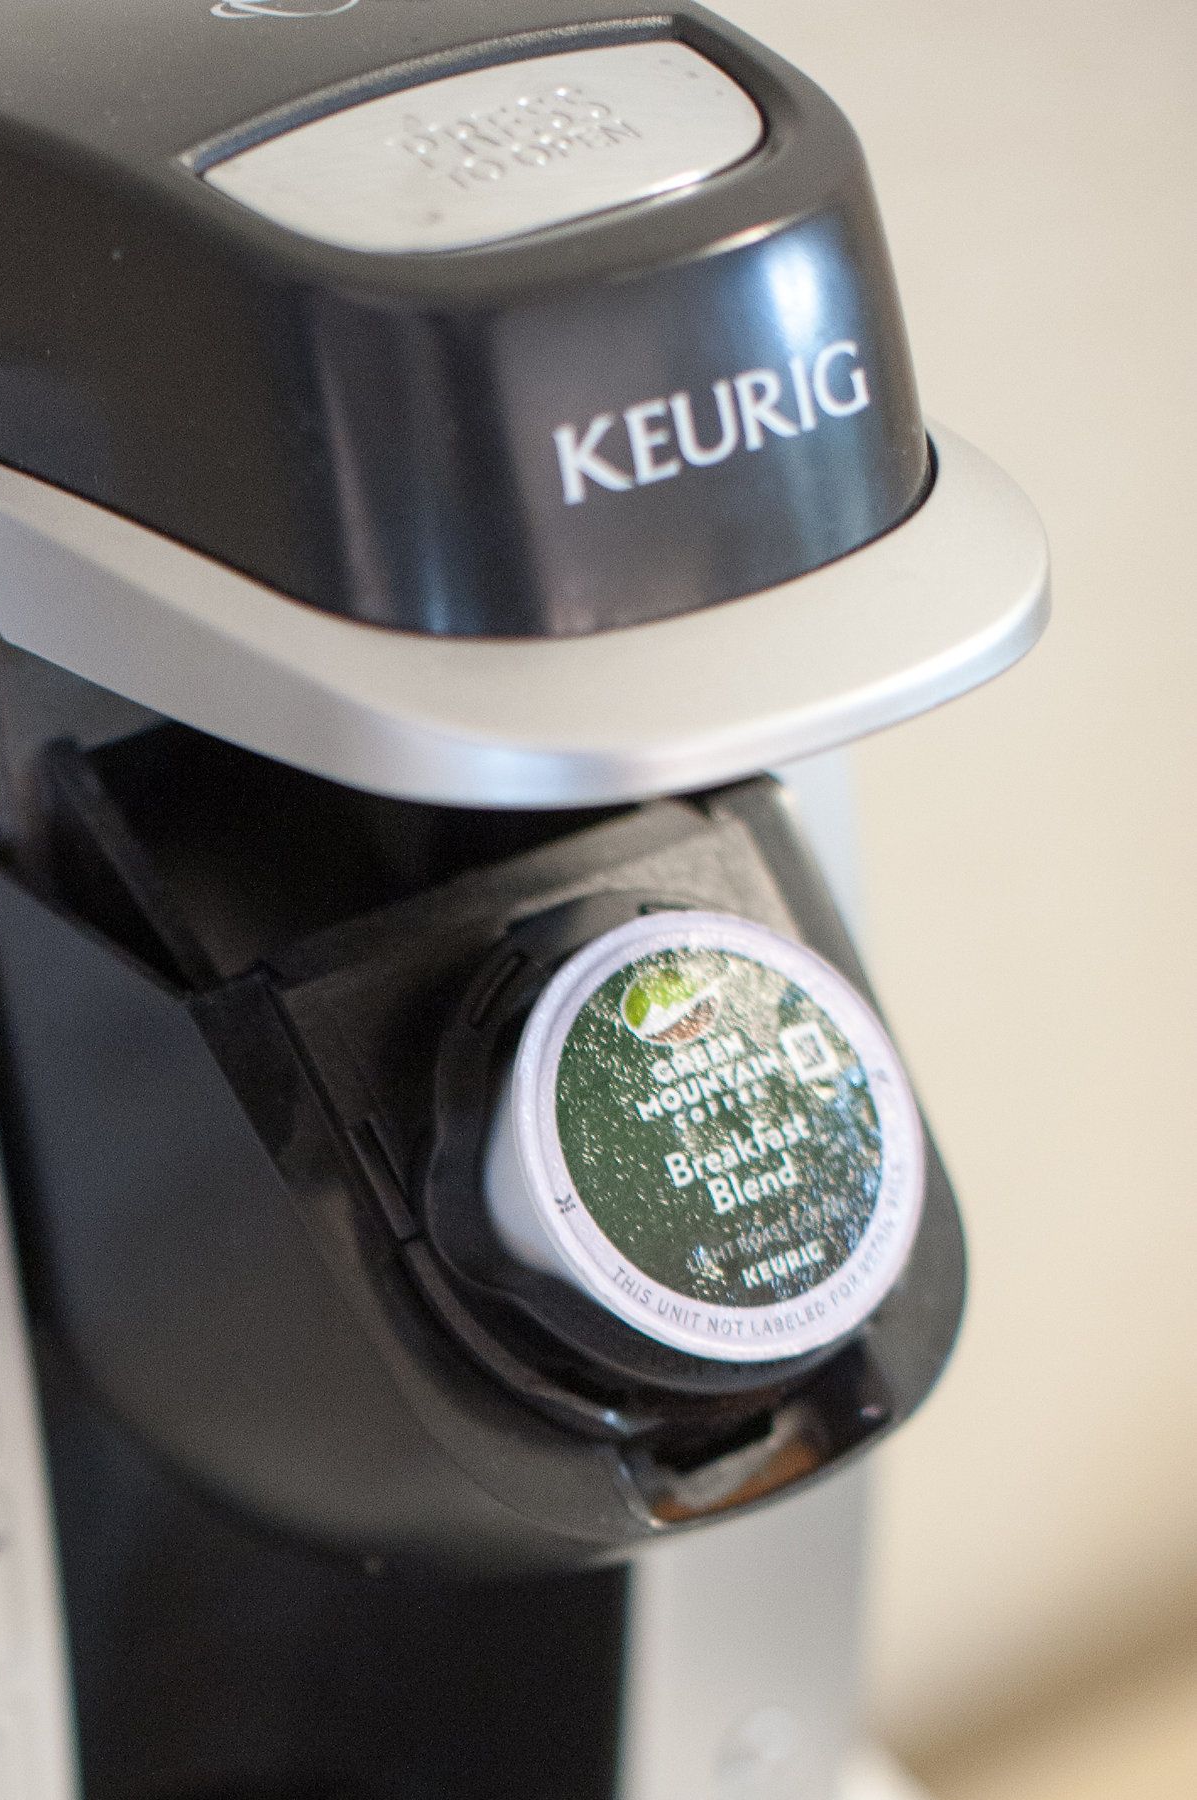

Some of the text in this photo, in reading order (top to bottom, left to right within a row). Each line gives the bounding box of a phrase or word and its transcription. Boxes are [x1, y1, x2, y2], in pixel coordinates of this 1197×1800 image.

[553, 339, 870, 505] KEURIG
[636, 1048, 782, 1122] MOUNTAIN
[652, 1032, 745, 1084] GREEN
[663, 1113, 811, 1188] Breakfast
[706, 1151, 799, 1215] Blend
[741, 1239, 825, 1289] KEURIG
[612, 1266, 652, 1304] THIS
[657, 1298, 701, 1329] UNIT
[707, 1316, 743, 1337] NOT
[751, 1300, 826, 1337] LABELED
[830, 1272, 859, 1306] FOR
